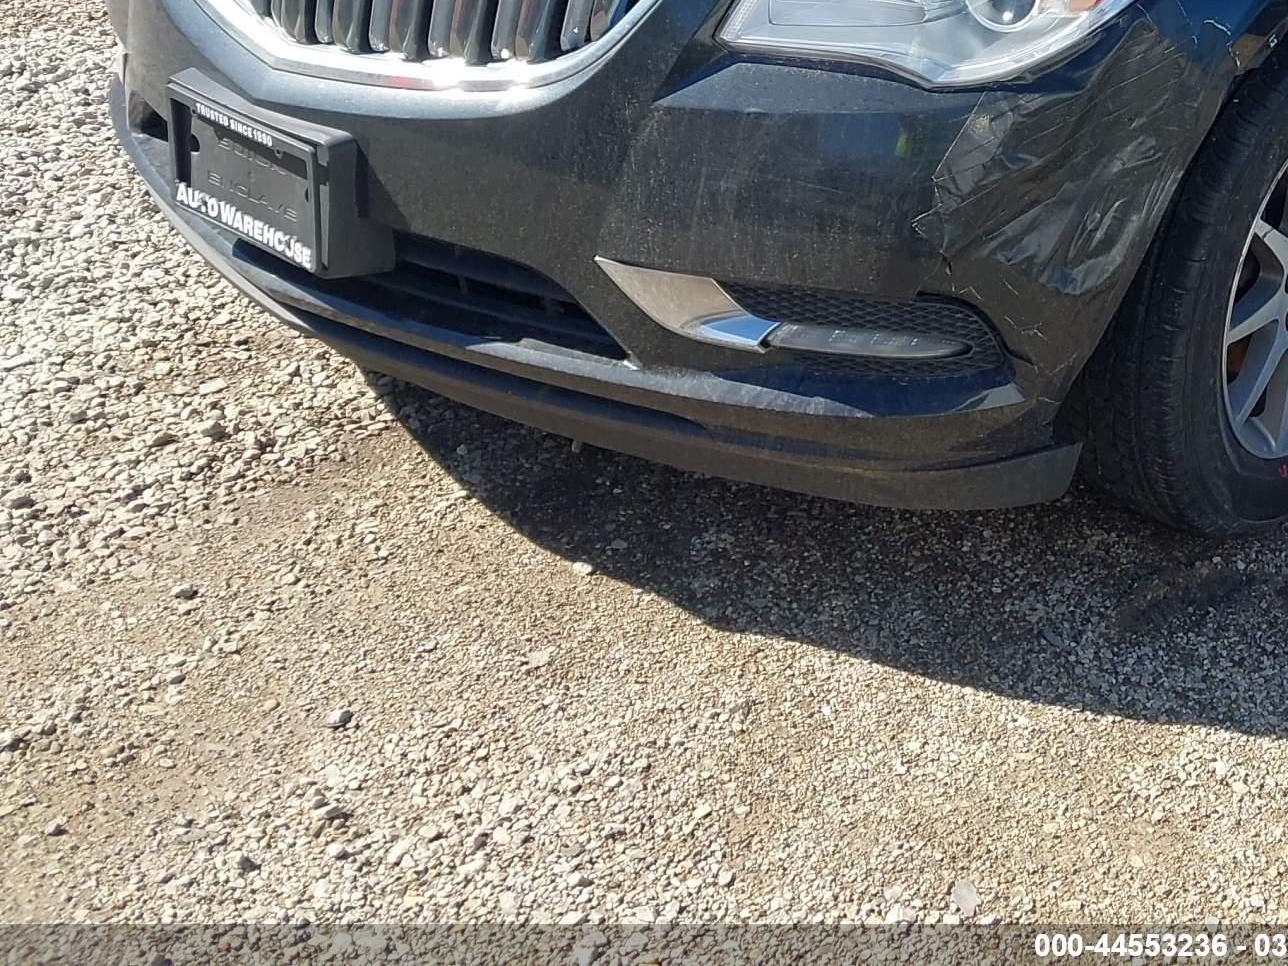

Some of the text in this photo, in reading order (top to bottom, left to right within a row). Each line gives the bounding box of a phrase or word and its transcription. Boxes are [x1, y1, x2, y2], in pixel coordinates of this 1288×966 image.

[195, 102, 273, 147] TRUSTED SINCE 1990
[175, 180, 312, 269] AUTO WAREHOUSE
